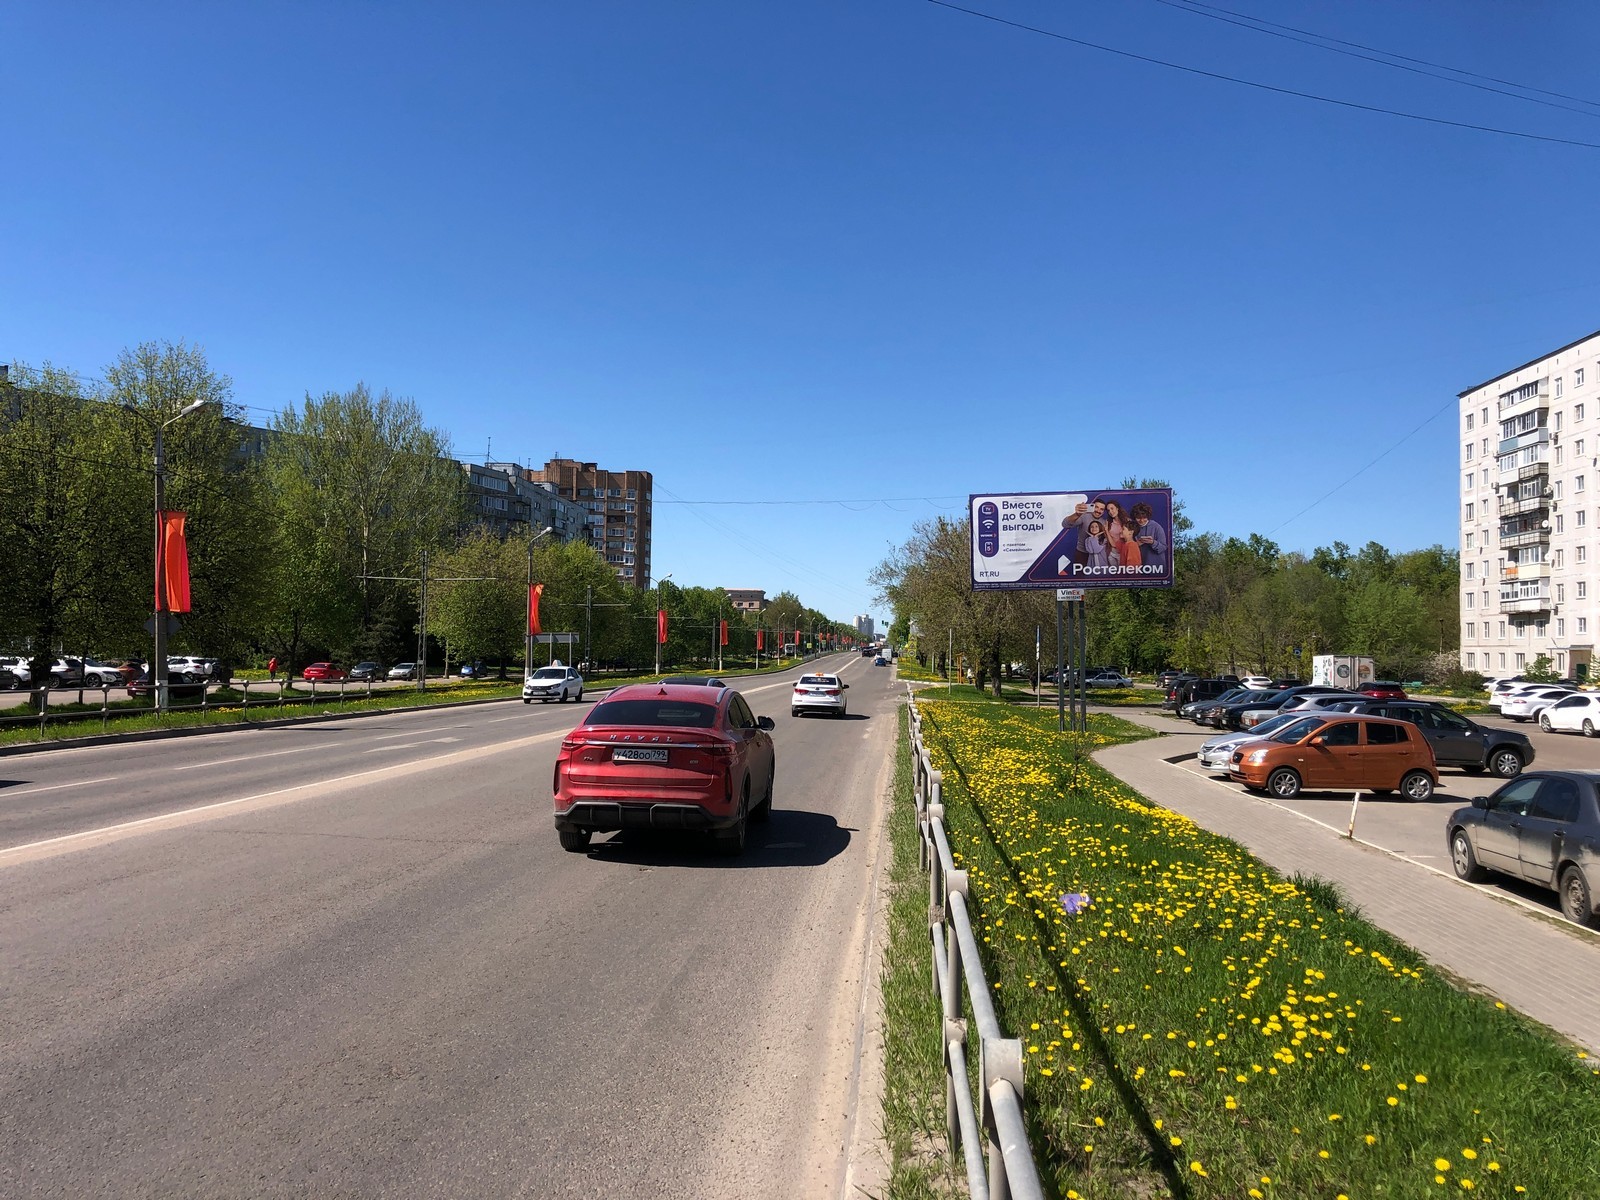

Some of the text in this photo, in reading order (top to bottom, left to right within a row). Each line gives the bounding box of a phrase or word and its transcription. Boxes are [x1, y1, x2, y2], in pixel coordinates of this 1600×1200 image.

[1002, 501, 1042, 509] Вместе
[1002, 510, 1044, 521] до 60%
[1002, 523, 1044, 531] выгоды
[1073, 563, 1164, 575] Ростелеком
[610, 734, 673, 742] HAVAL
